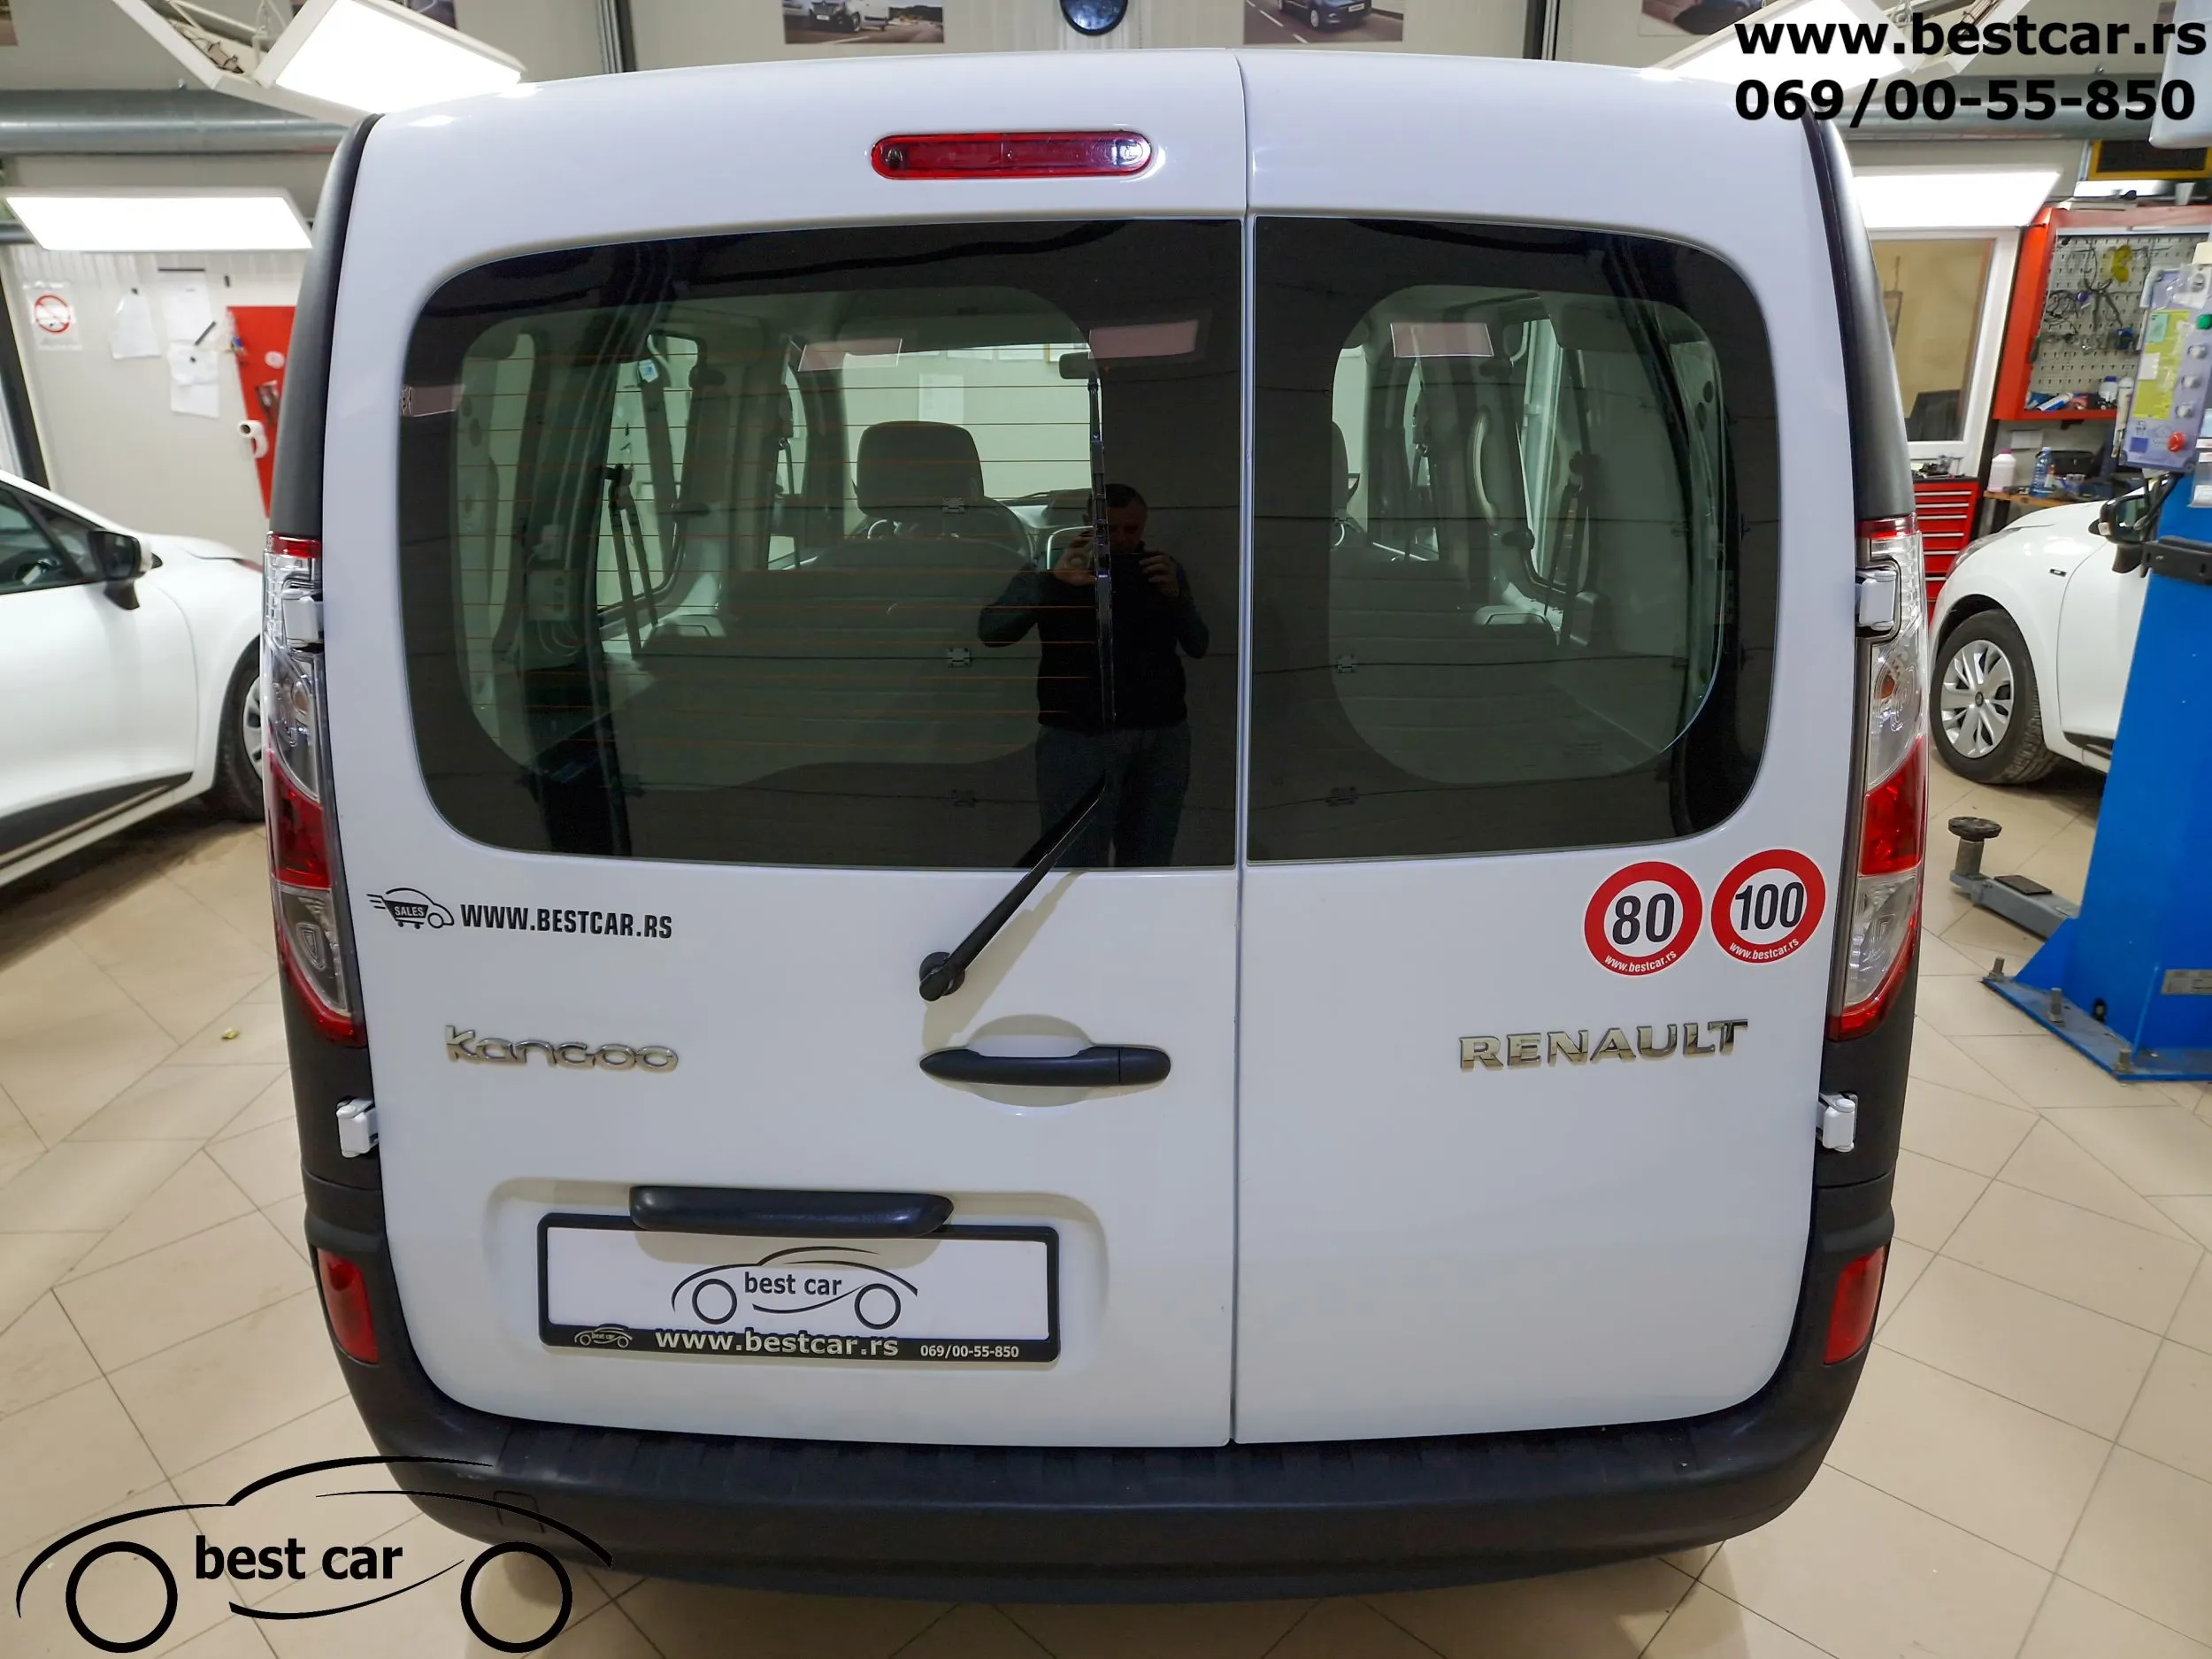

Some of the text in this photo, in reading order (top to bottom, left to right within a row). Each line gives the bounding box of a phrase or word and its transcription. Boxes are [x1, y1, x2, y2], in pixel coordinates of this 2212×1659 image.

[394, 905, 425, 918] SALES
[1735, 881, 1804, 931] 100
[461, 903, 672, 939] WWW.BESTCAR.RS
[1612, 893, 1675, 945] 80
[1604, 951, 1678, 972] www.bestcar.rs
[1730, 938, 1800, 960] www.bestcar.rs
[1459, 1018, 1748, 1071] RENAULT
[745, 1271, 842, 1296] best car
[656, 1330, 899, 1356] www.bestcar.rs
[919, 1343, 1019, 1359] 069/00-55-850
